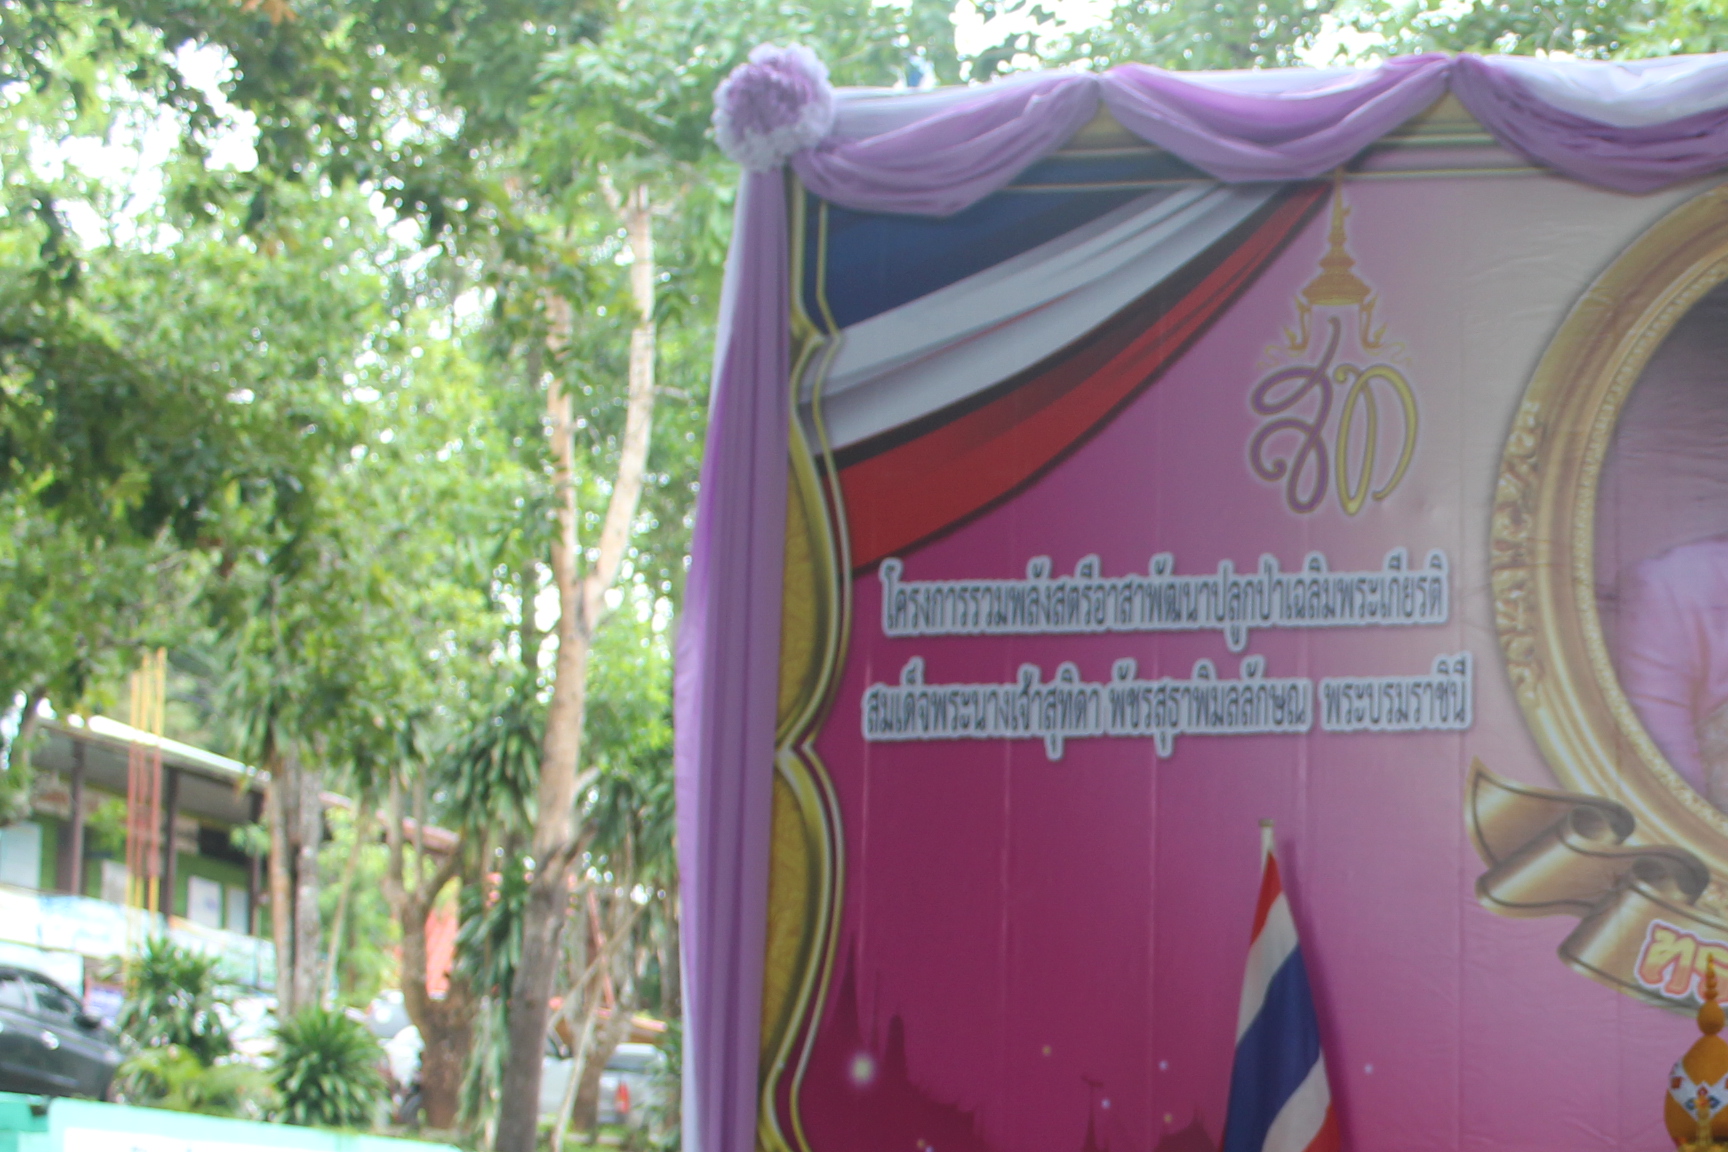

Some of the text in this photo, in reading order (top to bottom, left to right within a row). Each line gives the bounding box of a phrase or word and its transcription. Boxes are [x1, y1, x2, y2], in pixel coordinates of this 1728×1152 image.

[882, 550, 1446, 650] โครงการรวมพลังสตรีอาสาพัฒนาปลูกป่าเฉลิมพระเกียรติ
[865, 654, 1468, 757] สมเด็จพระนางเจ้าสุทิดา พัชรสุธาพิมลลักษณ พระบรมราชินี
